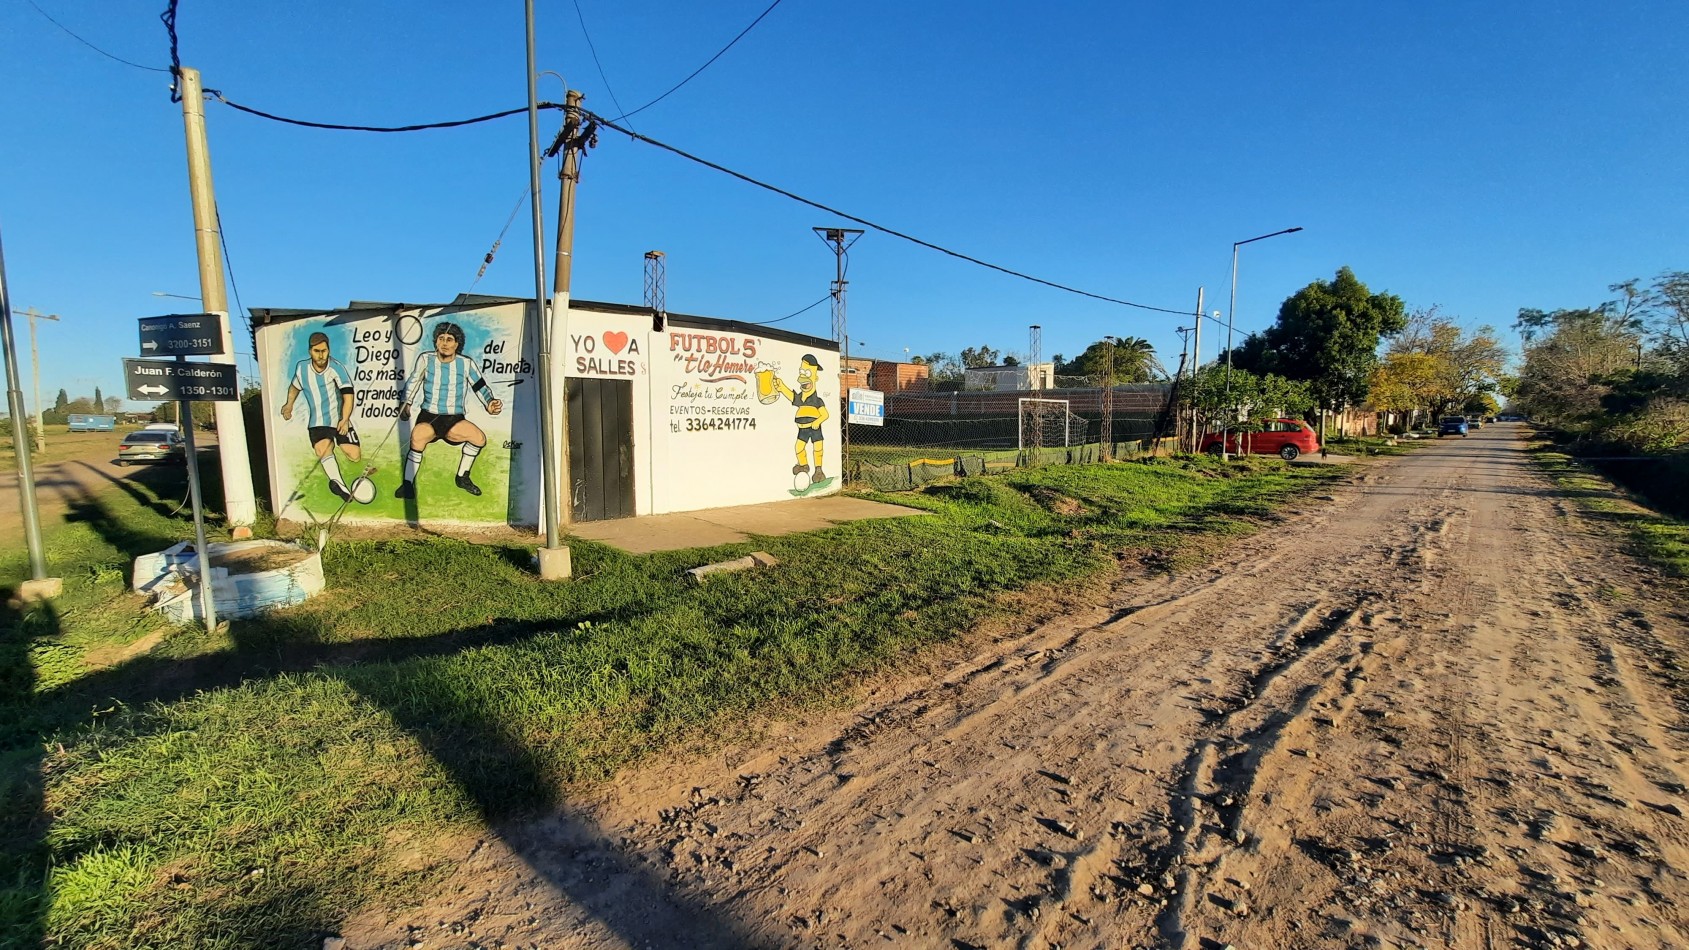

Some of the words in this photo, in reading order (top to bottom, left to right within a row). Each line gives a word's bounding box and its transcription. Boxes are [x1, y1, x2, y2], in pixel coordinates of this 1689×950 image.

[178, 321, 201, 329] Saenz
[352, 327, 381, 343] Leo
[385, 330, 393, 343] y
[670, 332, 740, 354] FUTBOL
[168, 339, 212, 349] 3200-3151
[483, 339, 506, 355] del
[570, 334, 596, 354] YO
[627, 338, 640, 355] A
[355, 345, 400, 366] Diego
[134, 366, 163, 376] Juan
[165, 367, 175, 376] F.
[353, 366, 373, 381] los
[576, 356, 636, 376] SALLES
[180, 386, 234, 396] 1350-1301
[356, 386, 404, 406] grandes
[671, 381, 703, 403] Festeja
[704, 386, 713, 399] tu
[853, 402, 881, 416] VENDE
